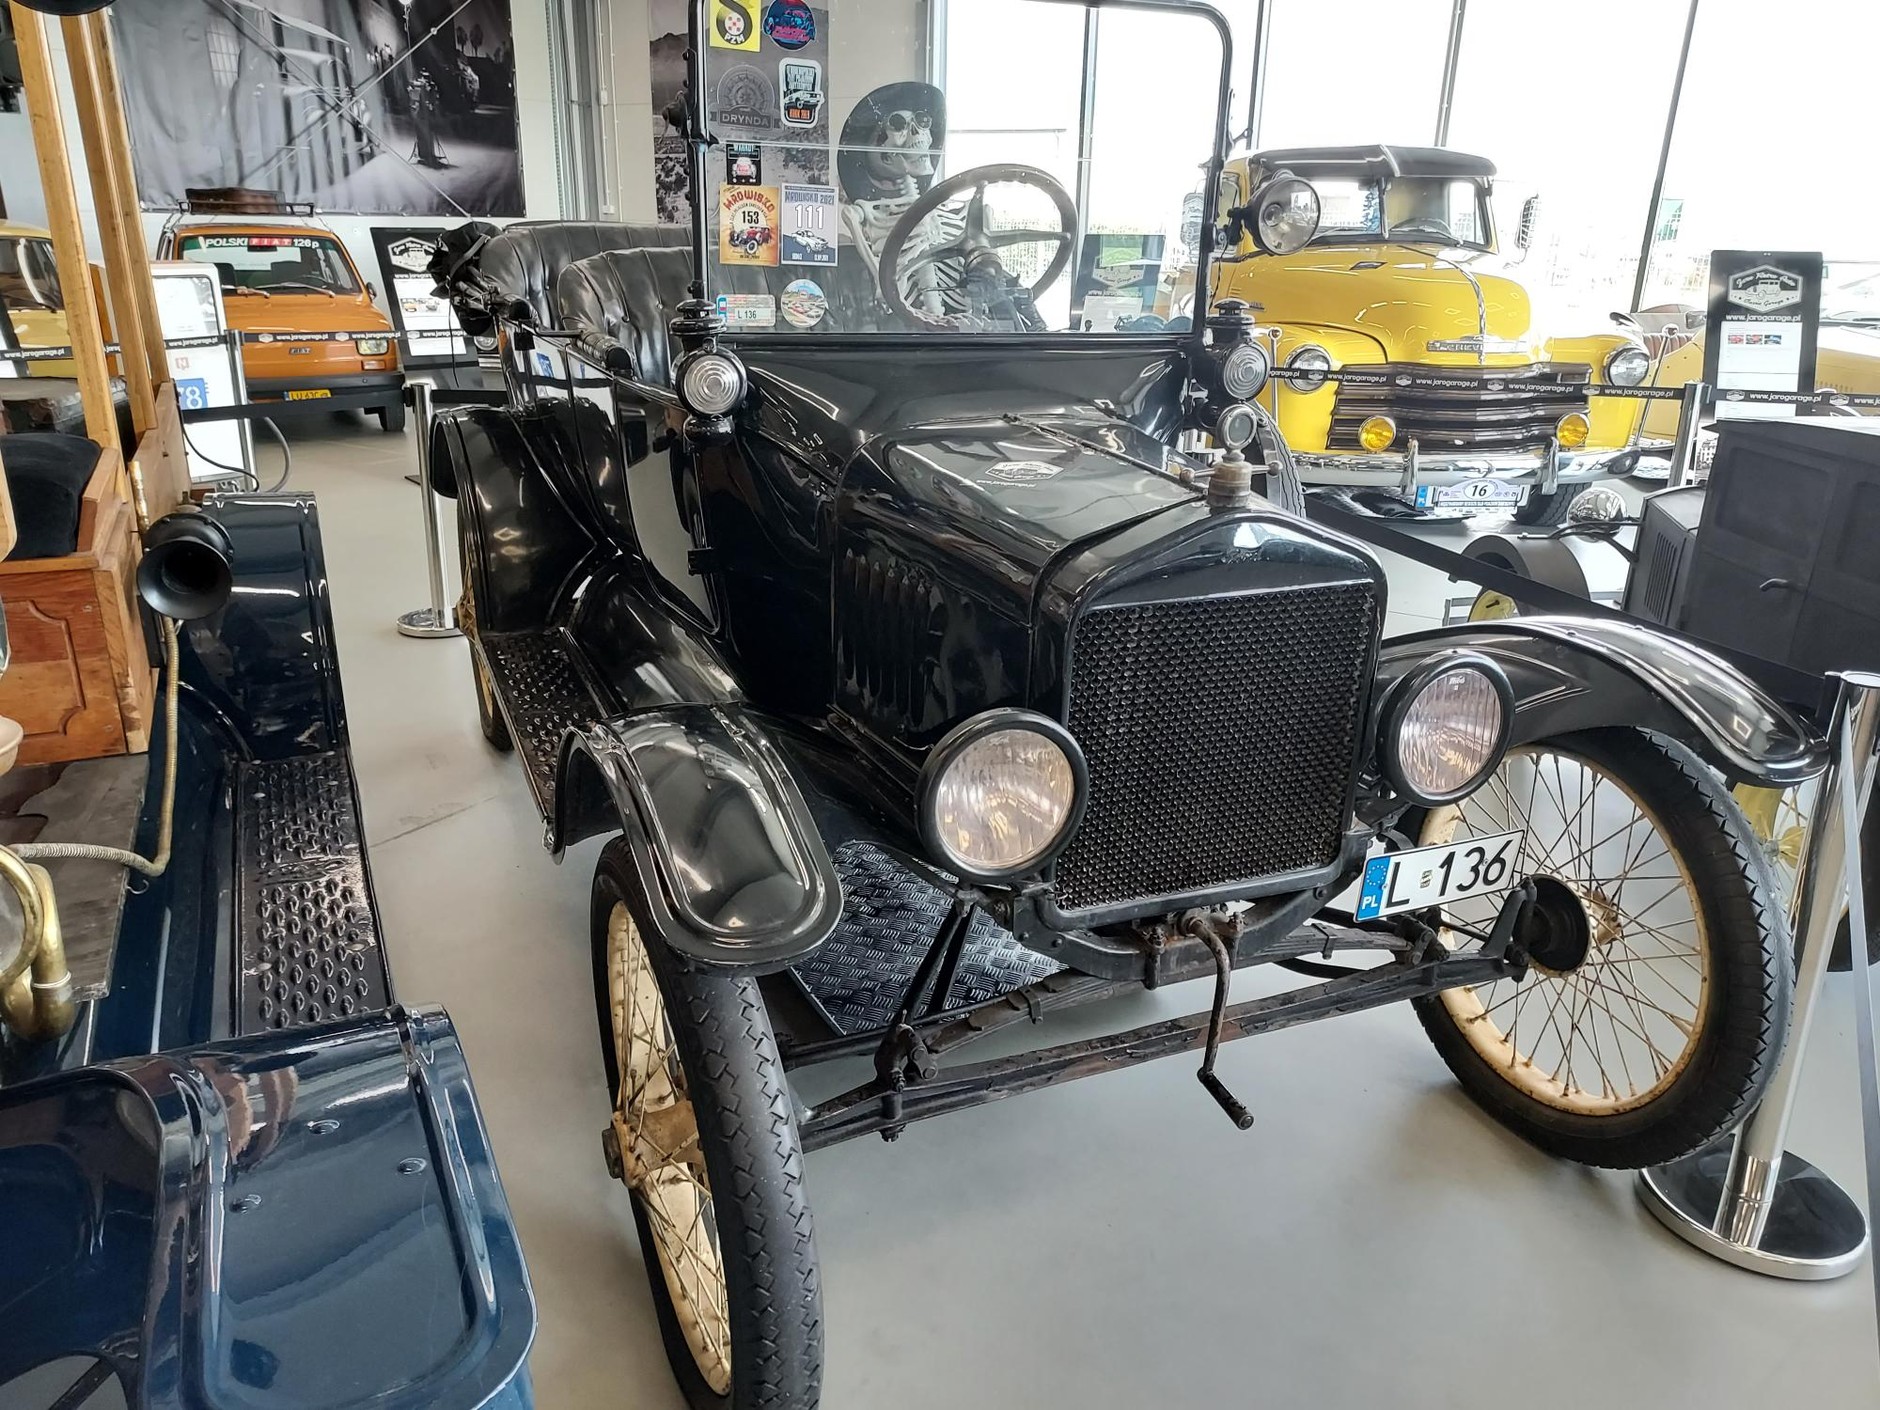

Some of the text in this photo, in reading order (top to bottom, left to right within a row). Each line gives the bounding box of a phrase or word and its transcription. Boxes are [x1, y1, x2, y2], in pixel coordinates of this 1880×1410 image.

[724, 32, 745, 44] PZM
[722, 113, 769, 126] DRYNDA
[742, 210, 759, 224] 153
[795, 204, 824, 229] 111
[205, 238, 319, 249] POLSKI FIAT 126p
[745, 310, 757, 318] 136
[1725, 314, 1801, 323] www.jarogarage.pl
[4, 348, 65, 358] www.jarogarage.pl
[1327, 373, 1387, 382] www.jarogarage.pl
[1416, 379, 1479, 387] www.jarogarage.pl
[1508, 383, 1574, 393] www.jarogarage.pl
[1605, 388, 1674, 398] www.jarogarage.pl
[1750, 392, 1822, 402] www.jarogarage.pl
[1471, 485, 1488, 497] 16
[1386, 839, 1514, 908] L 136
[1362, 896, 1379, 909] PL
